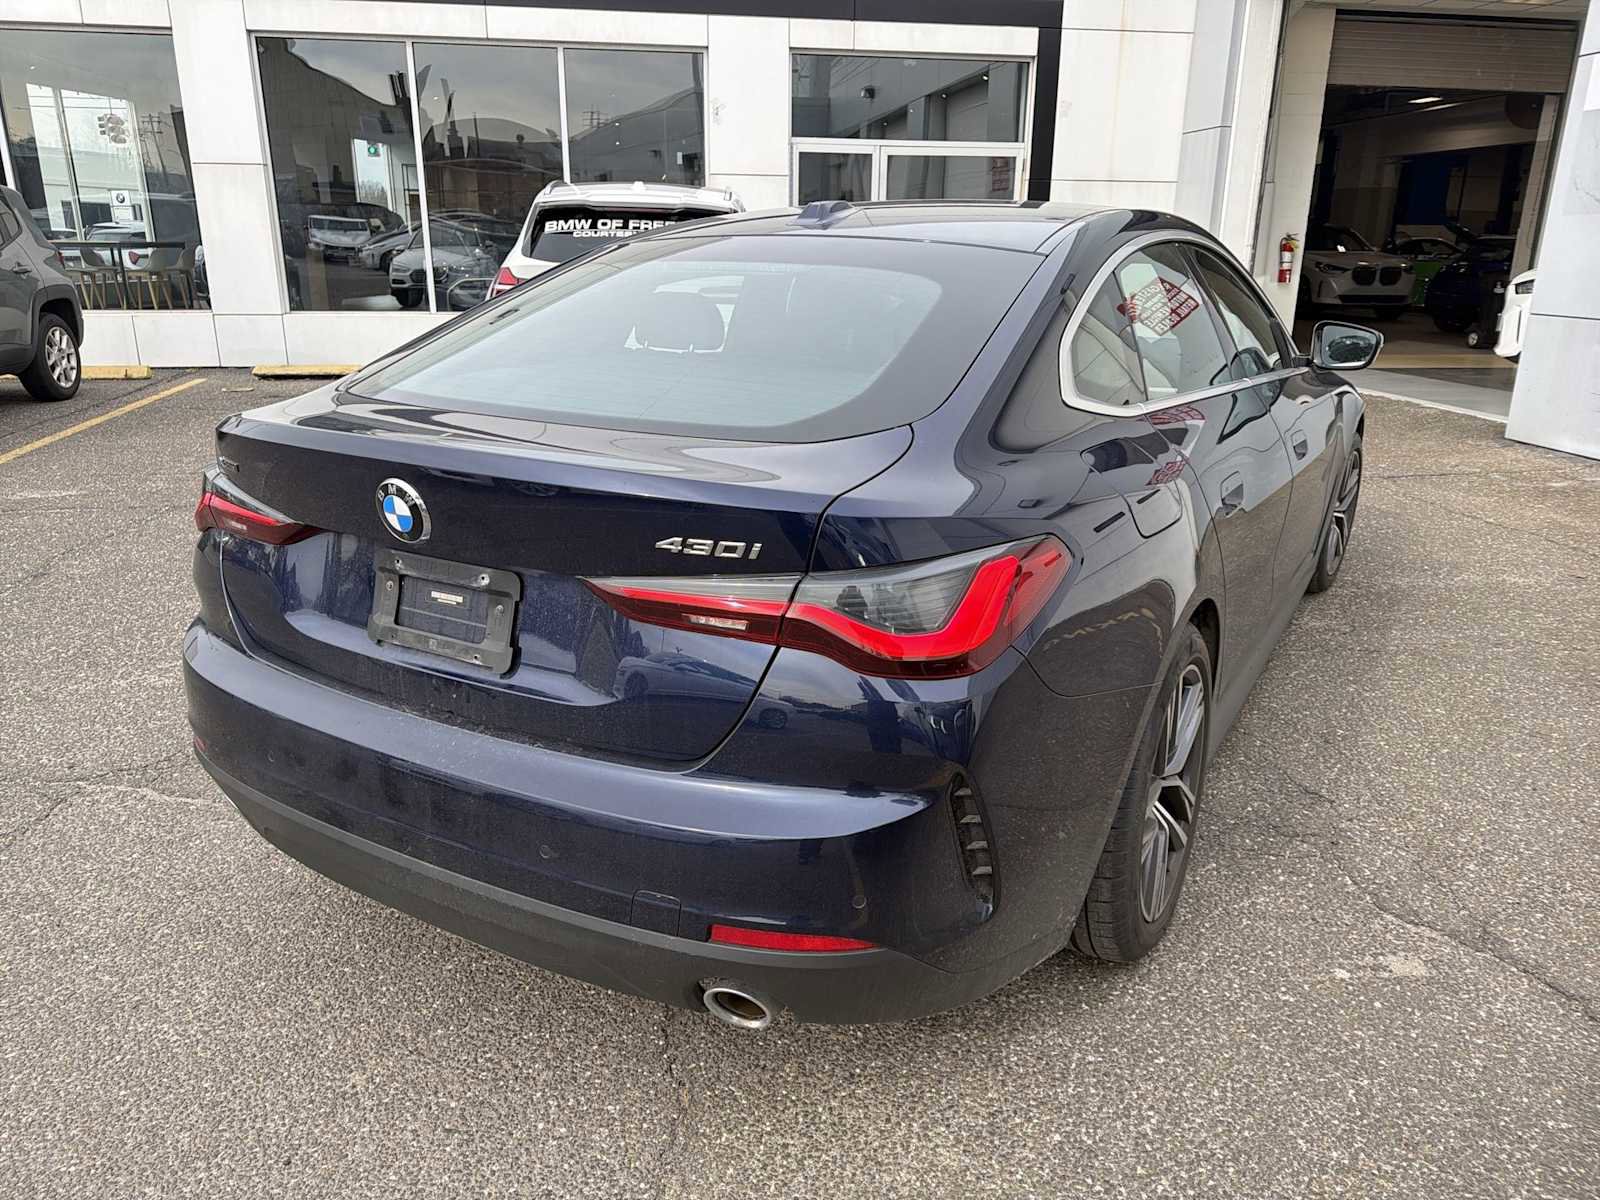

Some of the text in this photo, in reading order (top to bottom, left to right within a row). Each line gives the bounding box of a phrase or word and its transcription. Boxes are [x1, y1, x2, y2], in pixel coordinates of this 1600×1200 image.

[544, 219, 592, 232] BMW
[597, 219, 623, 230] OF
[573, 230, 637, 238] COURTES
[377, 483, 416, 507] BMW
[655, 537, 762, 560] 430i
